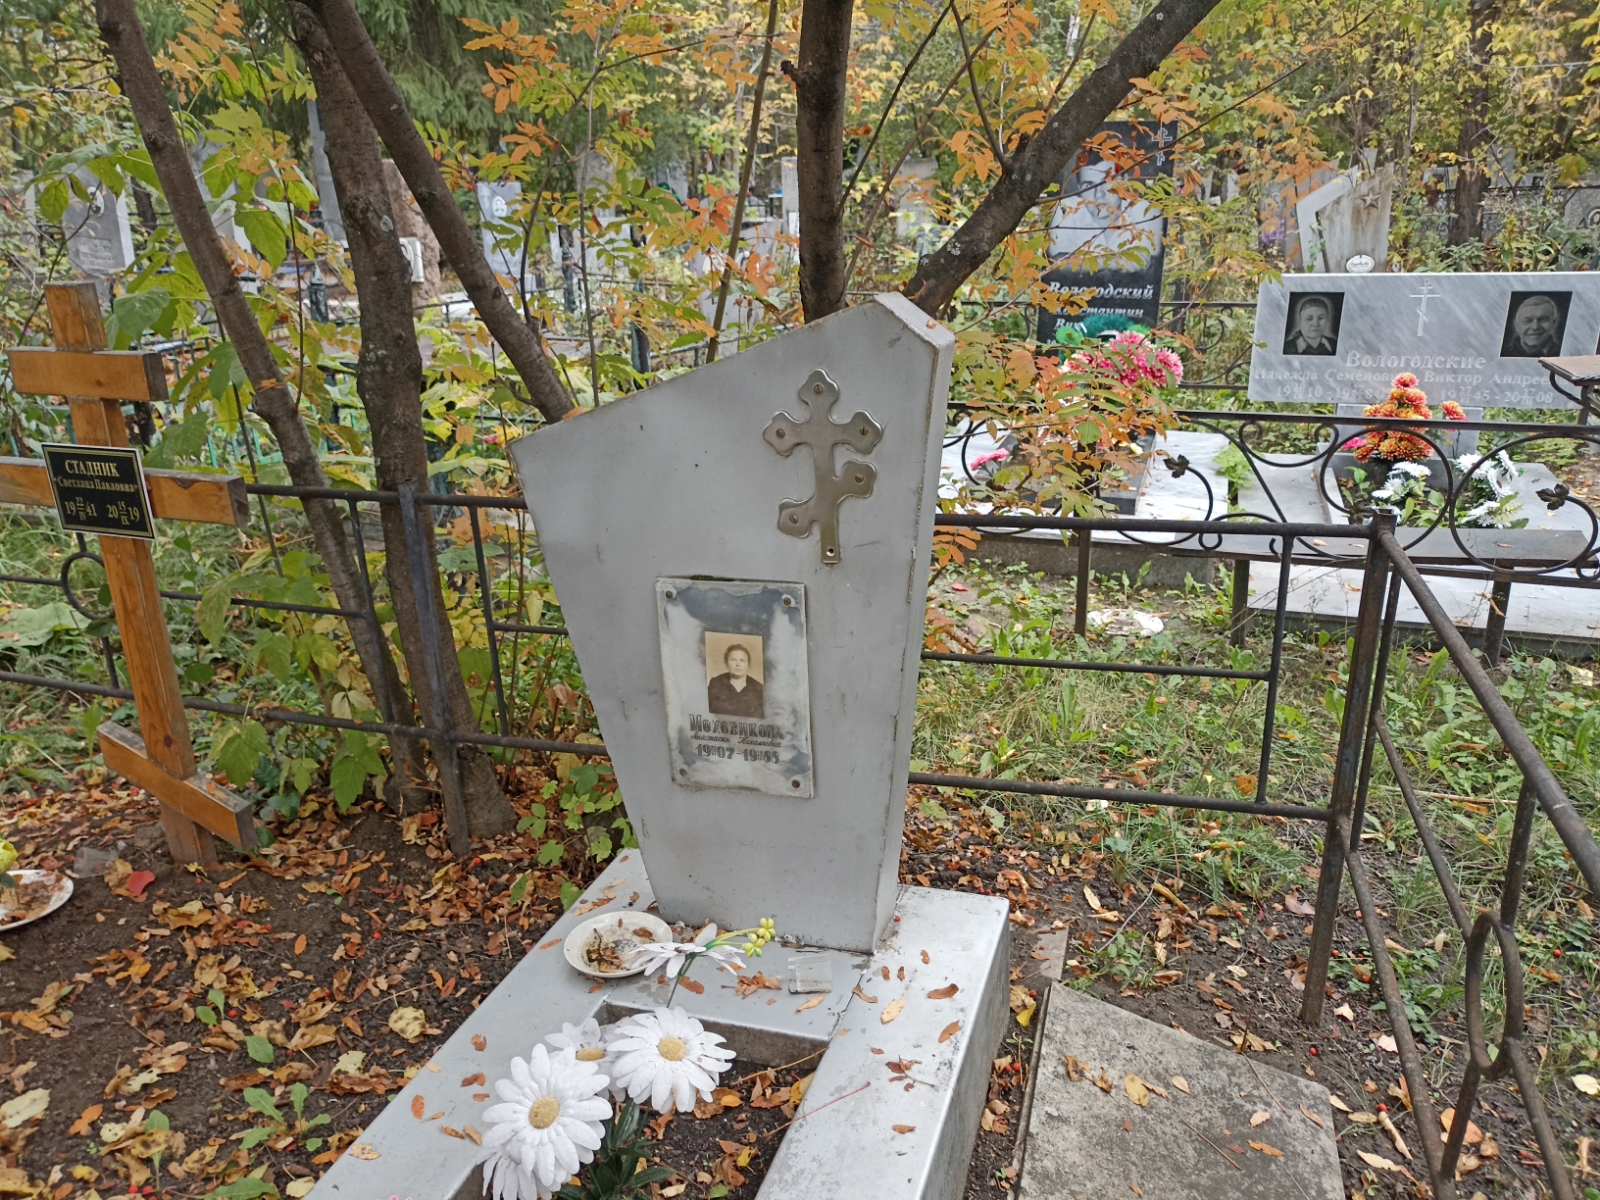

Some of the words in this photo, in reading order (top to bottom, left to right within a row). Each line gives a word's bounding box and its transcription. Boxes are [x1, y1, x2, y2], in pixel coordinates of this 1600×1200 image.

[1049, 281, 1155, 299] Волоодский
[1052, 304, 1145, 319] Костантин
[1347, 350, 1487, 369] Вологодские
[1254, 367, 1318, 382] Надежда
[1424, 370, 1482, 386] Виктор
[1490, 372, 1568, 388] Андрее
[65, 460, 120, 477] СТАДНИК
[58, 476, 95, 490] Светлана
[94, 478, 135, 493] Павловна
